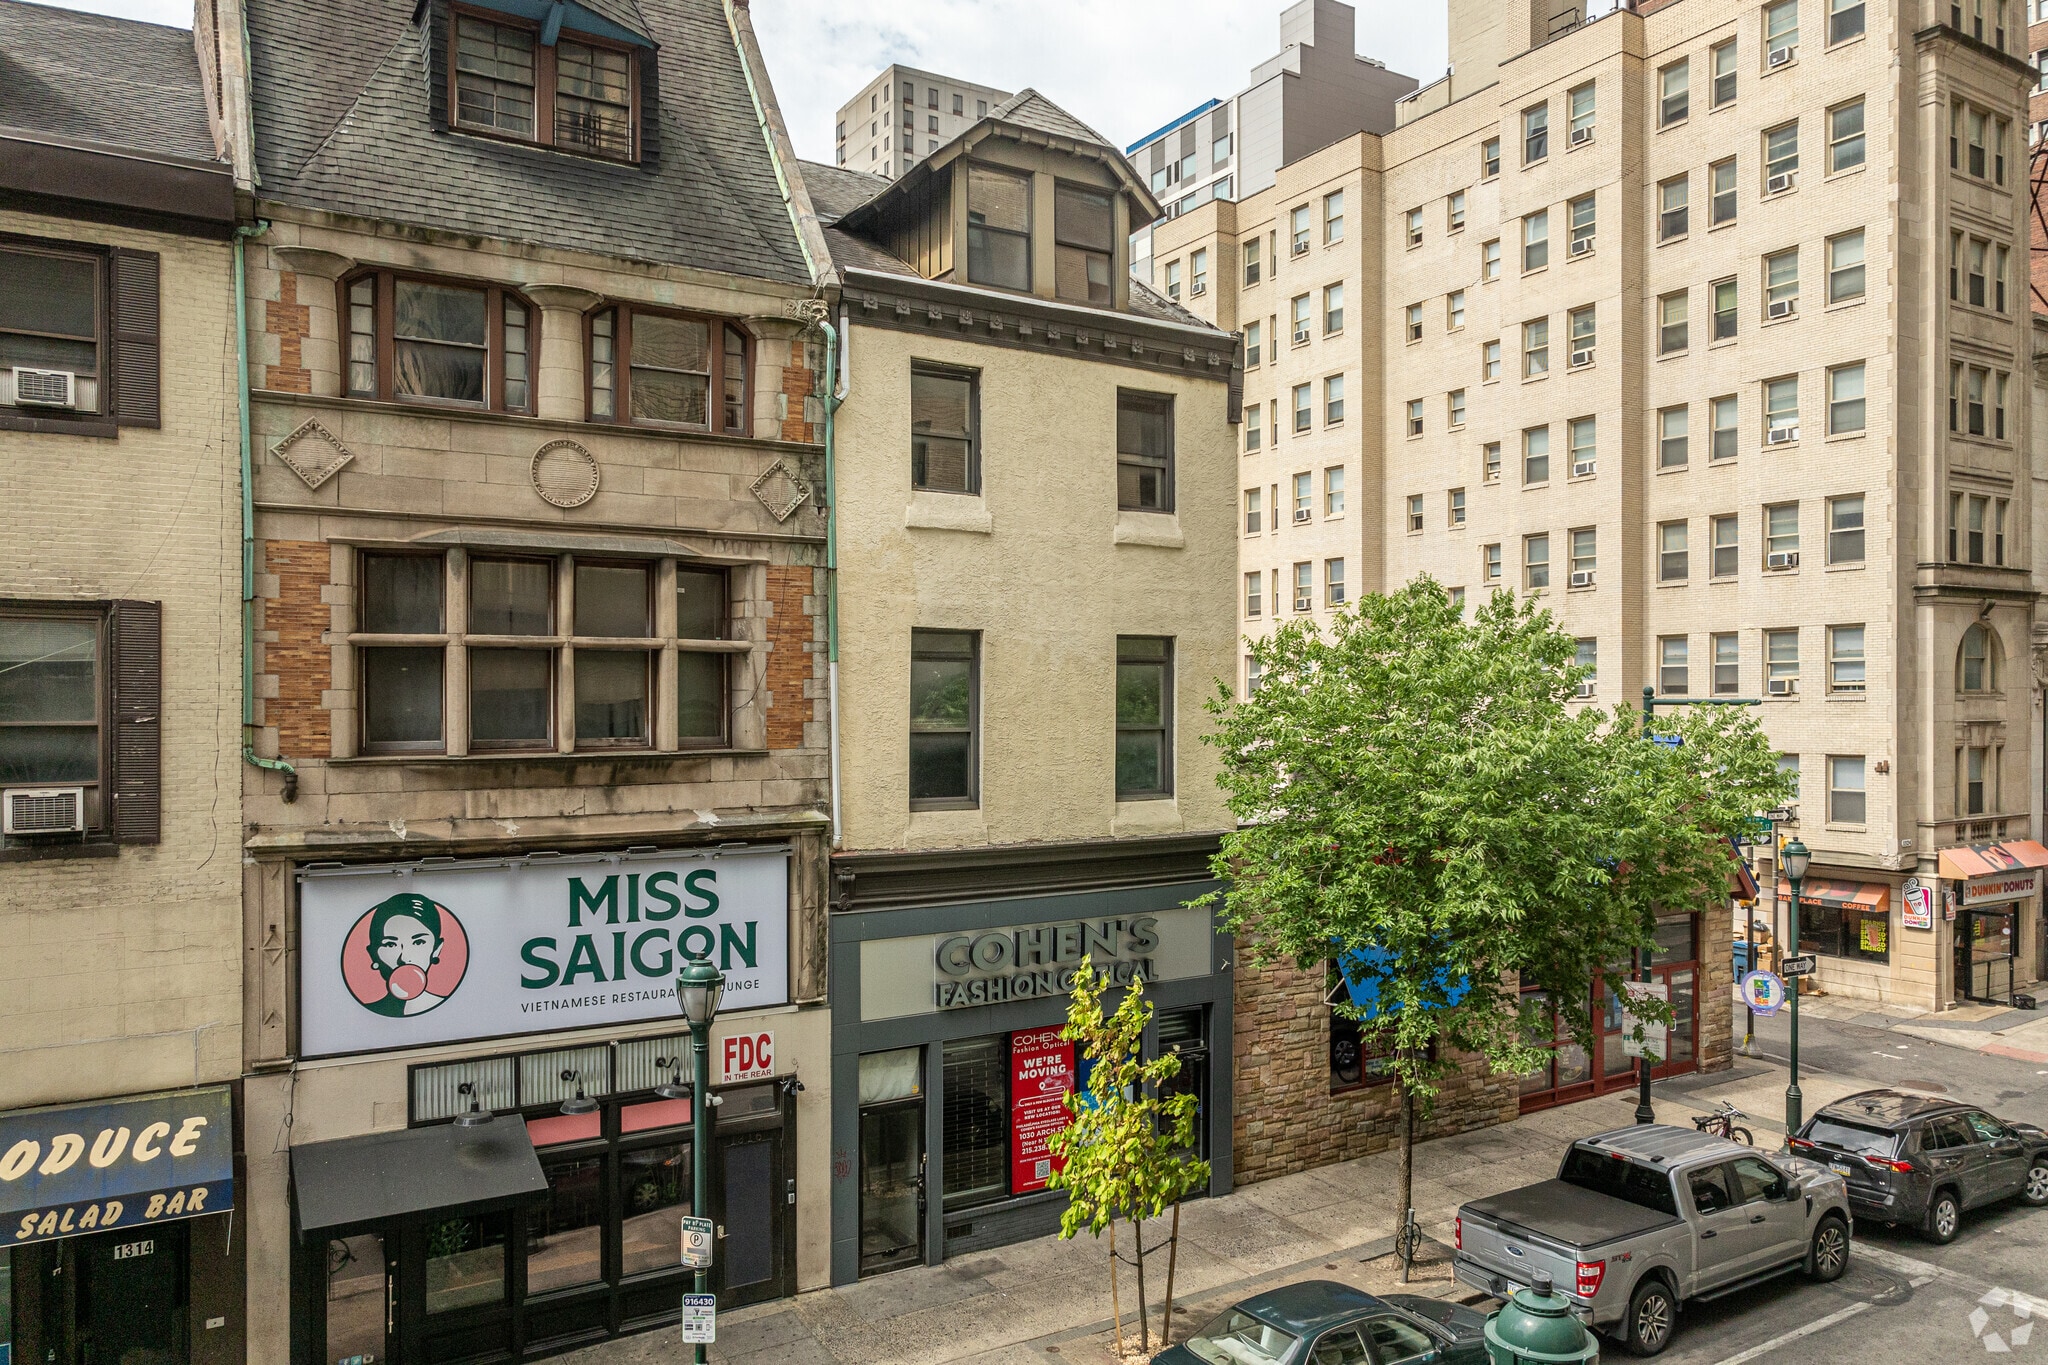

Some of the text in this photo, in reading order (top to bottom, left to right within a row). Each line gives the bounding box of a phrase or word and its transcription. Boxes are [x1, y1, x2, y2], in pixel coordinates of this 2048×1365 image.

[567, 869, 720, 927] MISS
[1799, 897, 1822, 905] PLACE
[1842, 902, 1870, 911] COFFEE
[936, 917, 1159, 976] COHEN'S
[520, 921, 759, 989] SAIGON
[1786, 962, 1806, 972] ONE WAY
[936, 959, 1159, 1007] FASHION OTICAL
[521, 995, 606, 1013] VIETNAMESE
[612, 988, 676, 1004] RESTAURA
[1013, 1030, 1061, 1046] COHEN'
[1013, 1038, 1070, 1054] Fashion Optical
[725, 1033, 771, 1073] FDC
[1024, 1054, 1062, 1068] WE'RE
[734, 1072, 748, 1080] THE
[750, 1069, 771, 1078] REAR
[1019, 1064, 1066, 1080] MOVING
[1019, 1131, 1035, 1140] 1030
[1036, 1127, 1056, 1137] ARCH
[0, 1117, 208, 1181] ODUCE
[1022, 1139, 1037, 1148] (Near
[15, 1187, 209, 1239] SALAD BAR
[116, 1241, 152, 1259] 1314
[685, 1298, 714, 1306] 916430
